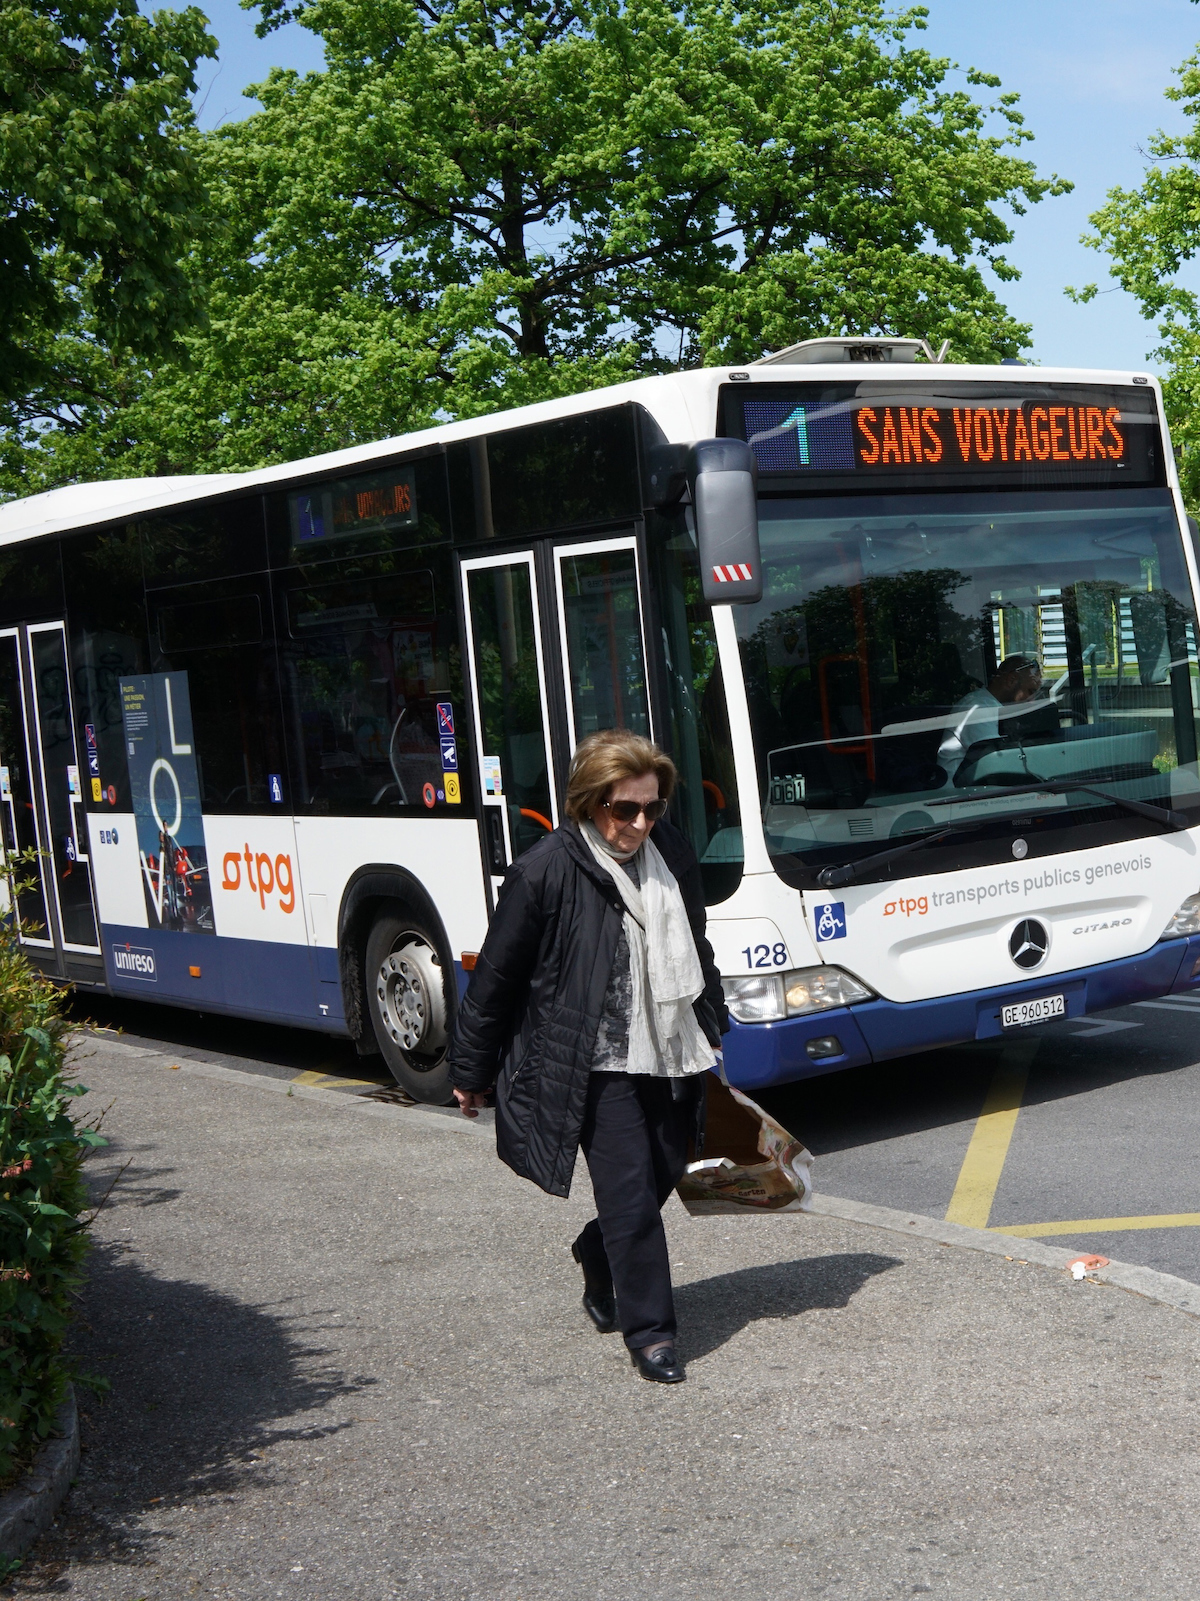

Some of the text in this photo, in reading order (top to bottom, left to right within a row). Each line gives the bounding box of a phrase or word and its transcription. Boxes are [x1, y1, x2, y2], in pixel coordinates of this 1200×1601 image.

[781, 407, 810, 465] 1
[857, 407, 1124, 464] SANS VOYAGEURS
[931, 879, 1020, 907] transports
[1023, 867, 1081, 896] publics
[1084, 854, 1152, 885] genevois
[115, 943, 154, 973] unireso
[742, 943, 787, 969] 128
